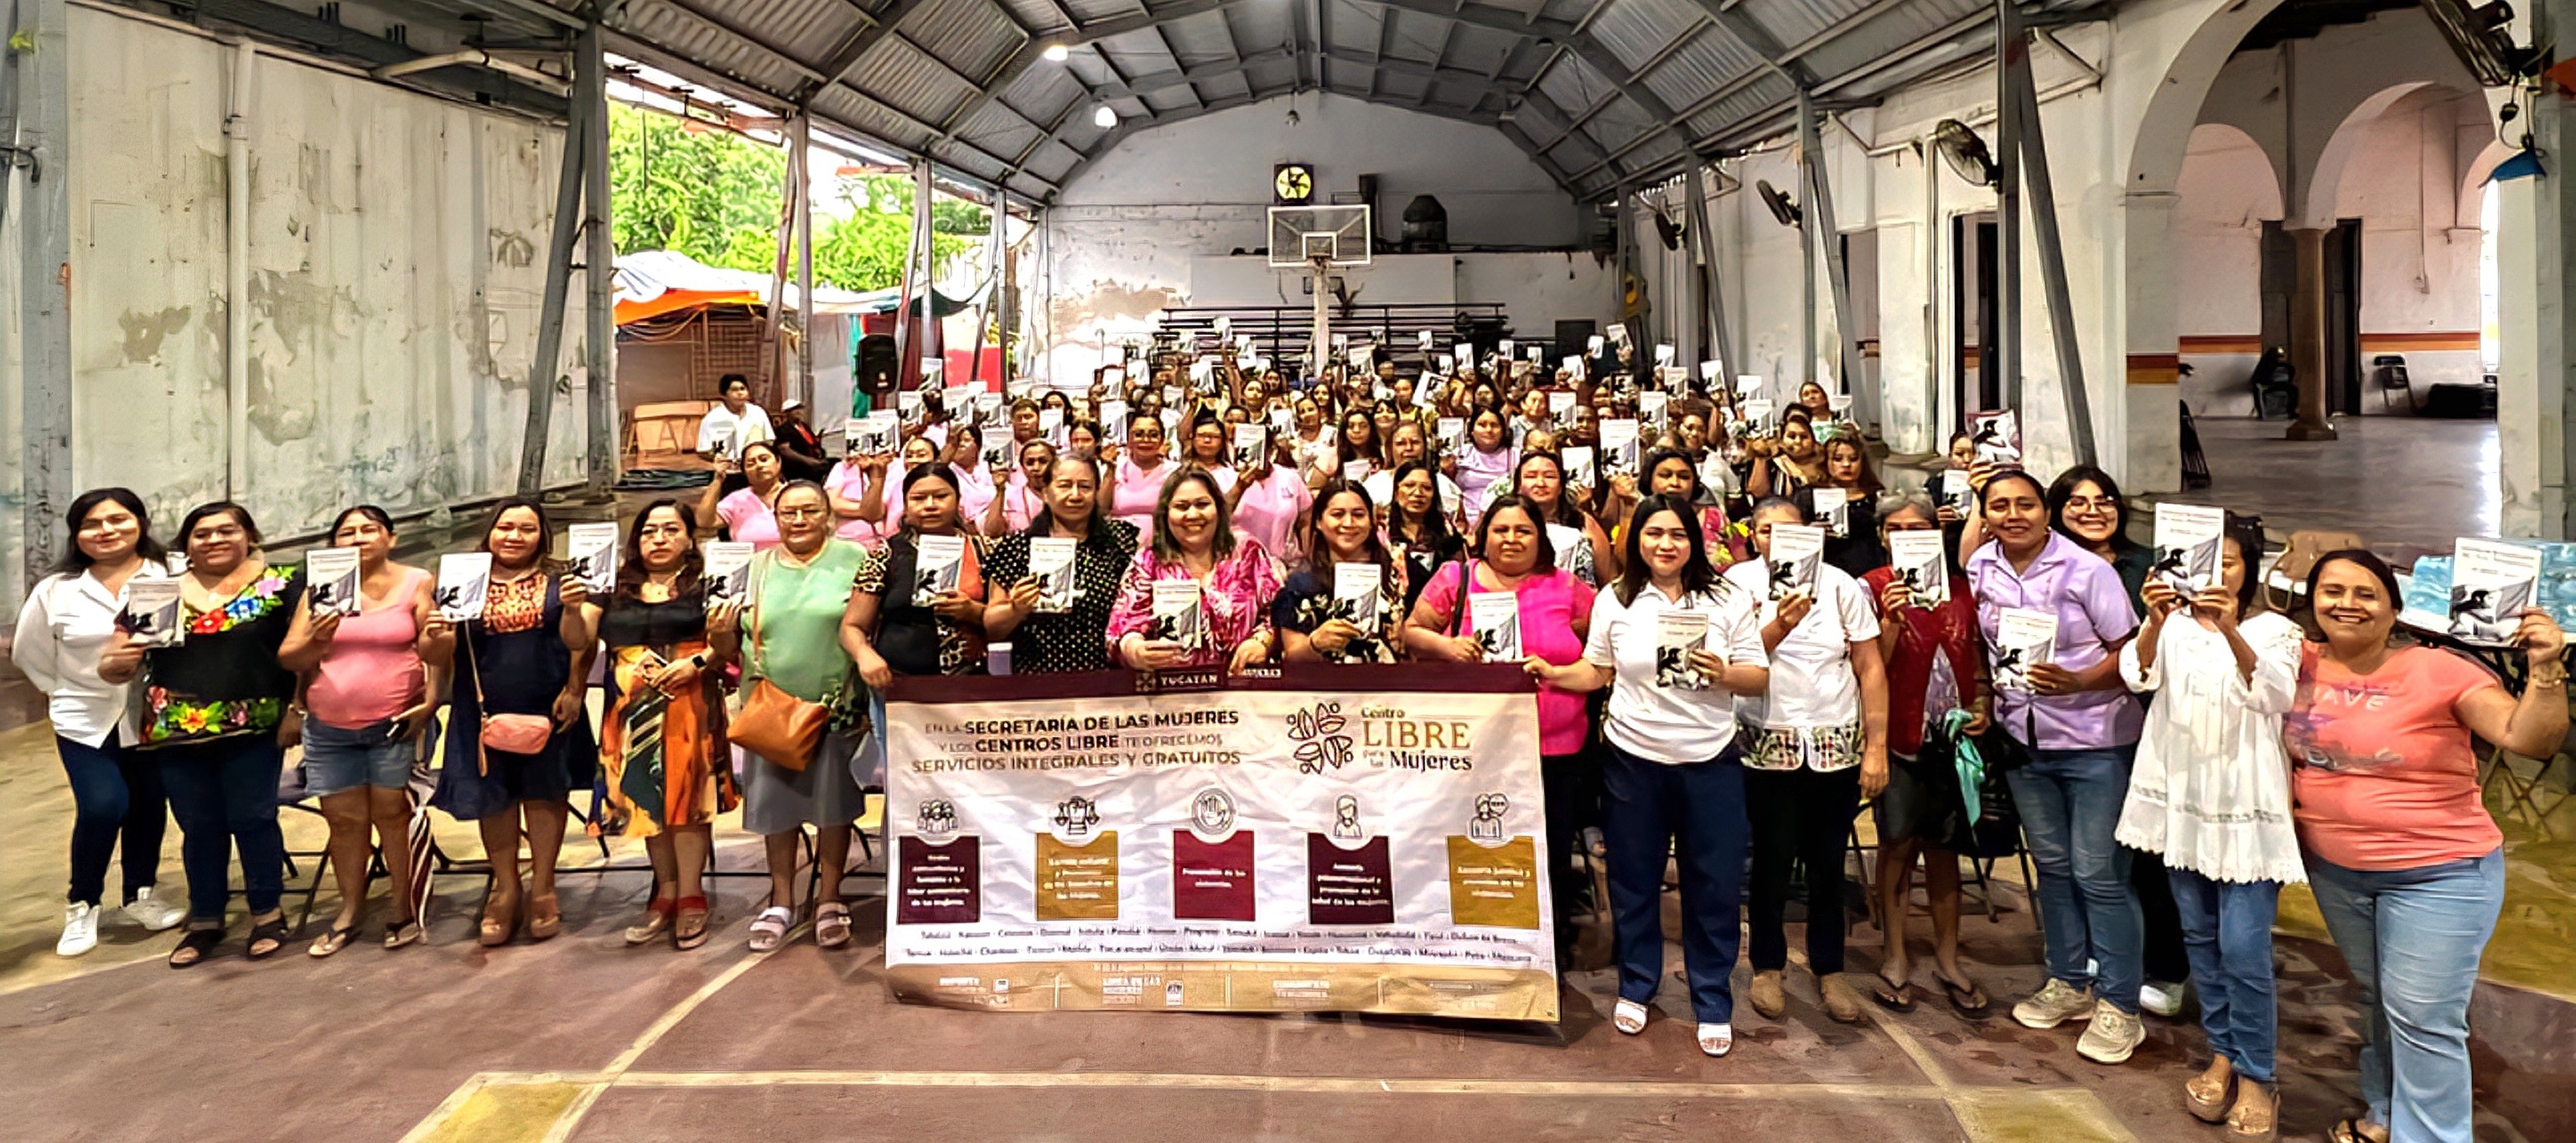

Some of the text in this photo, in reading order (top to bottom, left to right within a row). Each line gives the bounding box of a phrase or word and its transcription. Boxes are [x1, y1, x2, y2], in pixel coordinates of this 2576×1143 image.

[965, 715, 1080, 735] SECRETARÍA
[1087, 716, 1110, 732] DE
[1115, 714, 1149, 730] LAS
[1154, 710, 1239, 728] MUJERES
[1361, 708, 1406, 719] Centro
[975, 738, 1061, 752] CENTROS
[1067, 735, 1120, 750] LIBRE
[1363, 721, 1471, 749] LIBRE
[912, 750, 1241, 772] SERVICIOS INTEGRALES Y GRATUITOS
[1390, 751, 1473, 772] Mujeres
